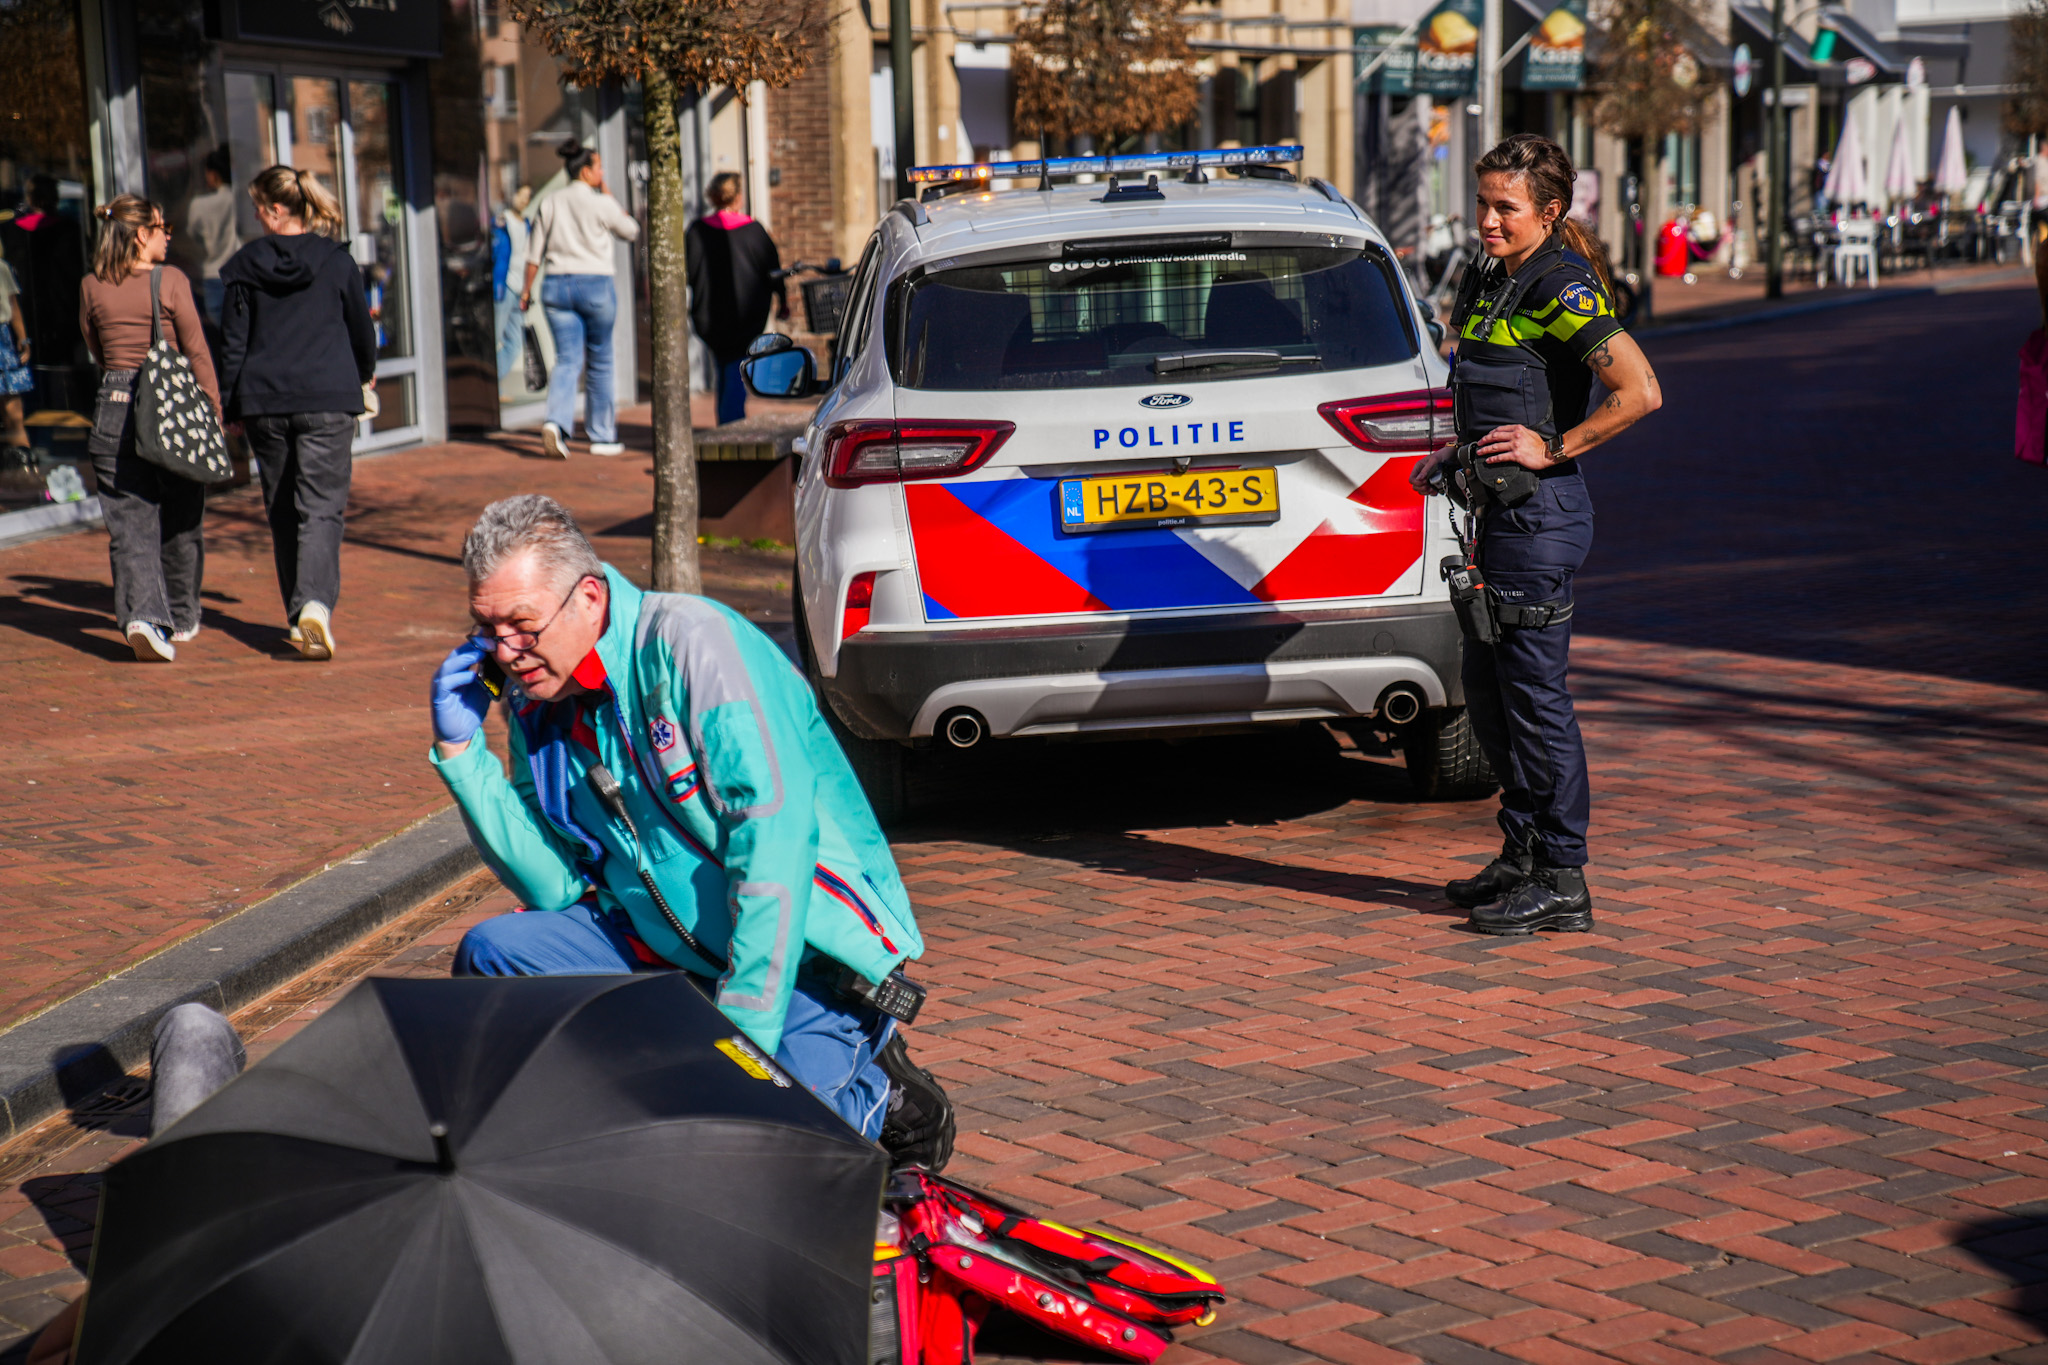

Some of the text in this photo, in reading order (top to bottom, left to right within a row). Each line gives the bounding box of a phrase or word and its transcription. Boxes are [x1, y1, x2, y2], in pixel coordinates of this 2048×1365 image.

[1417, 48, 1475, 70] Kaas
[1529, 43, 1584, 65] Kaas
[1149, 393, 1182, 406] Ford
[1094, 421, 1244, 449] POLITIE
[1097, 476, 1264, 515] HZB-43-S
[1067, 507, 1082, 517] NL
[1158, 517, 1186, 527] politie.nl
[1455, 575, 1469, 586] TQ
